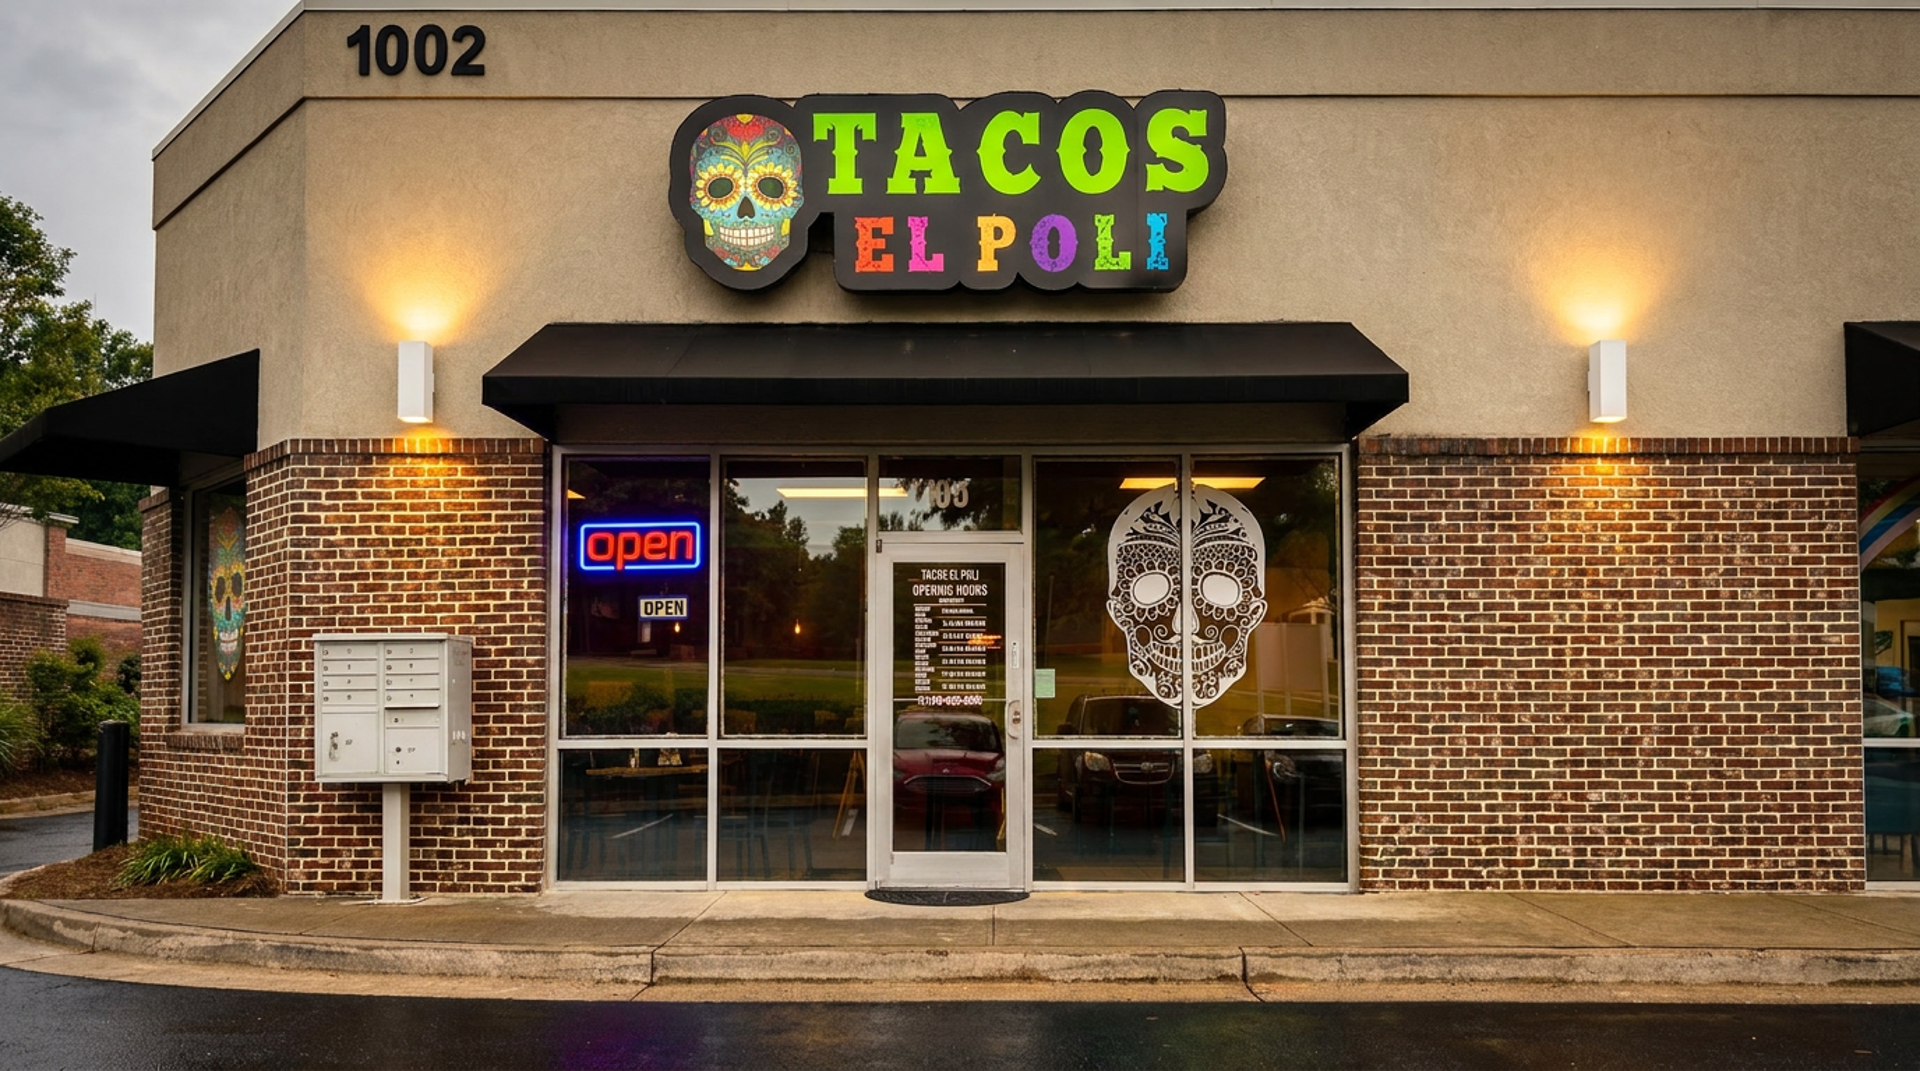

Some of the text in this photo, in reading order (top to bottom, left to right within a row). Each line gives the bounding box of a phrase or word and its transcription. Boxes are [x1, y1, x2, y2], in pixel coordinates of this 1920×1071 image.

[347, 24, 486, 76] 1002
[812, 108, 1209, 195] TACOS
[854, 213, 1168, 273] EL POLI
[587, 530, 693, 571] open
[644, 600, 684, 616] OPEN
